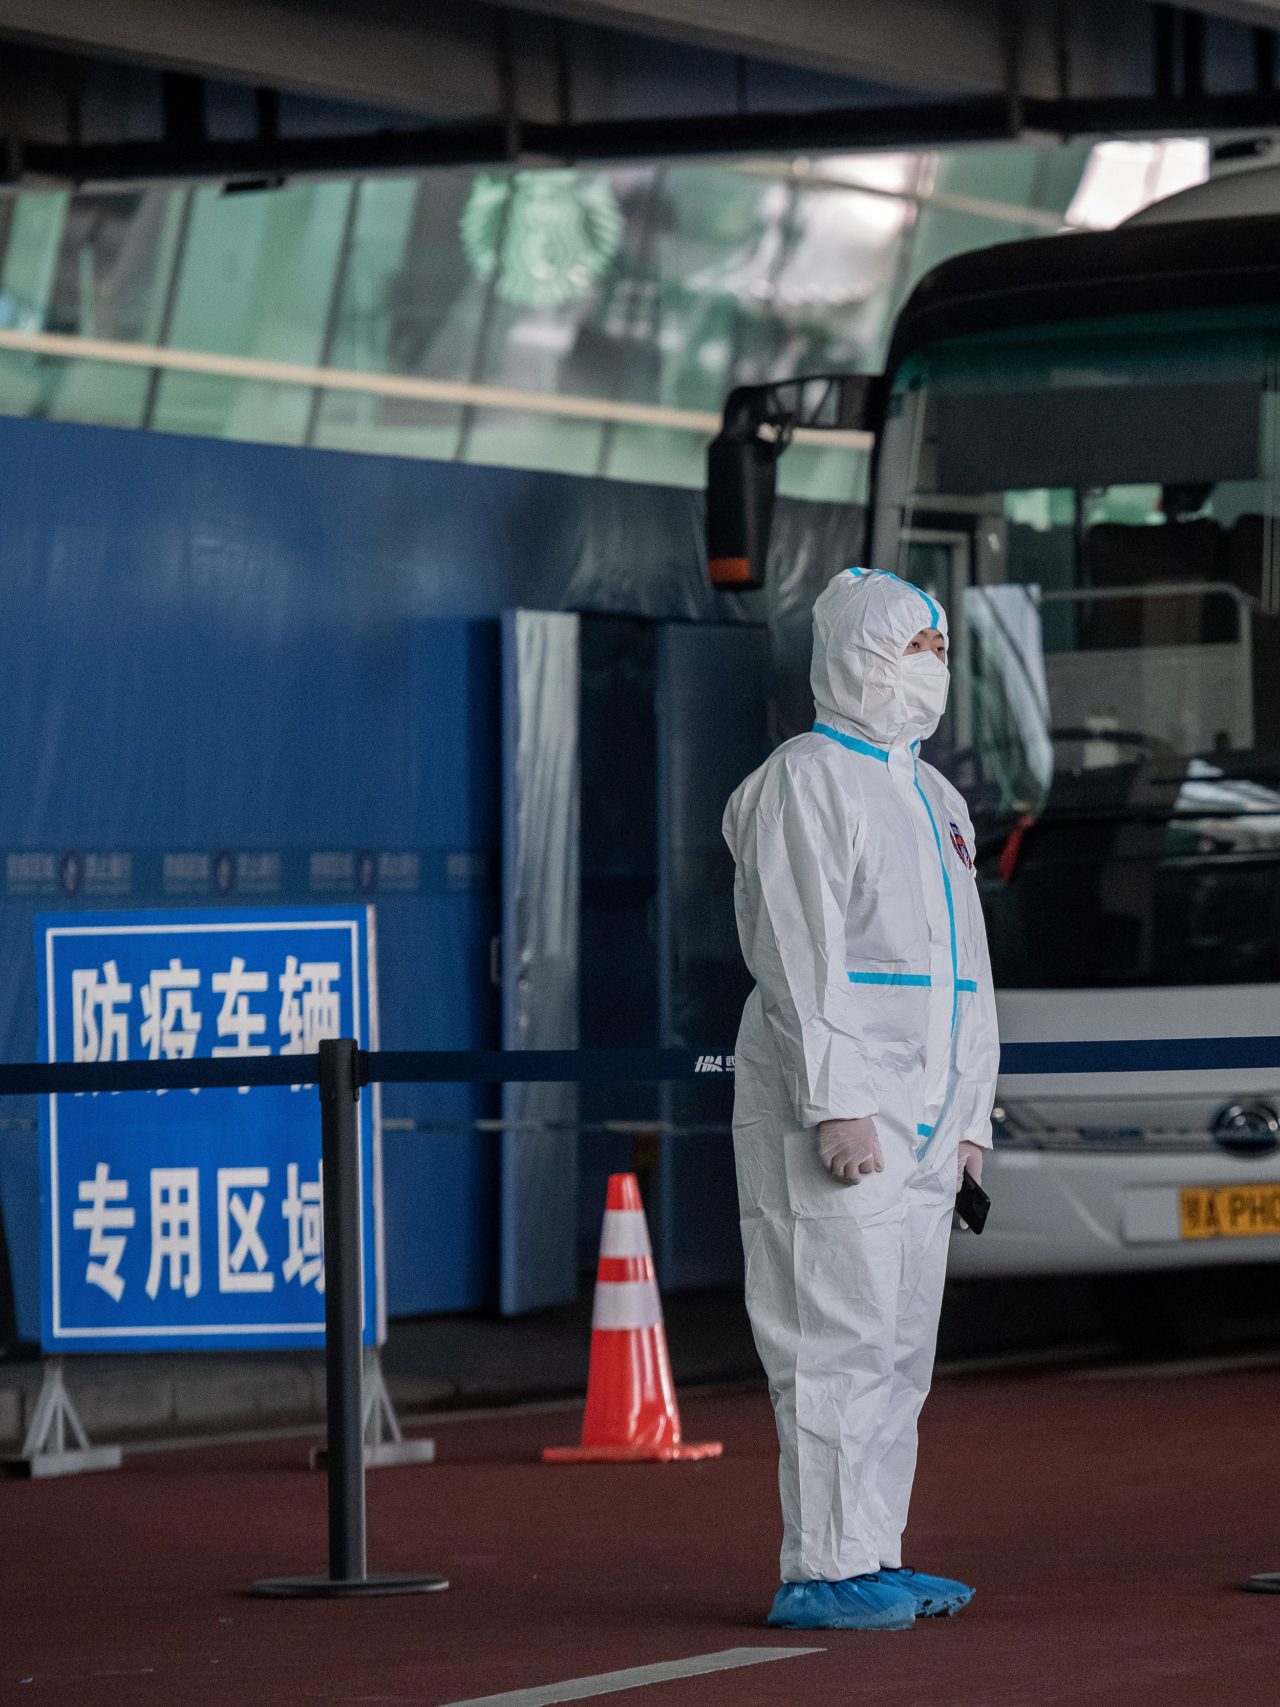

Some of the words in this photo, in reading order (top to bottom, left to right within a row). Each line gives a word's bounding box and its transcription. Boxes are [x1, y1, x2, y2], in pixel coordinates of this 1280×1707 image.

[72, 955, 341, 1097] 防疫车辆
[73, 1161, 325, 1303] 专用区域
